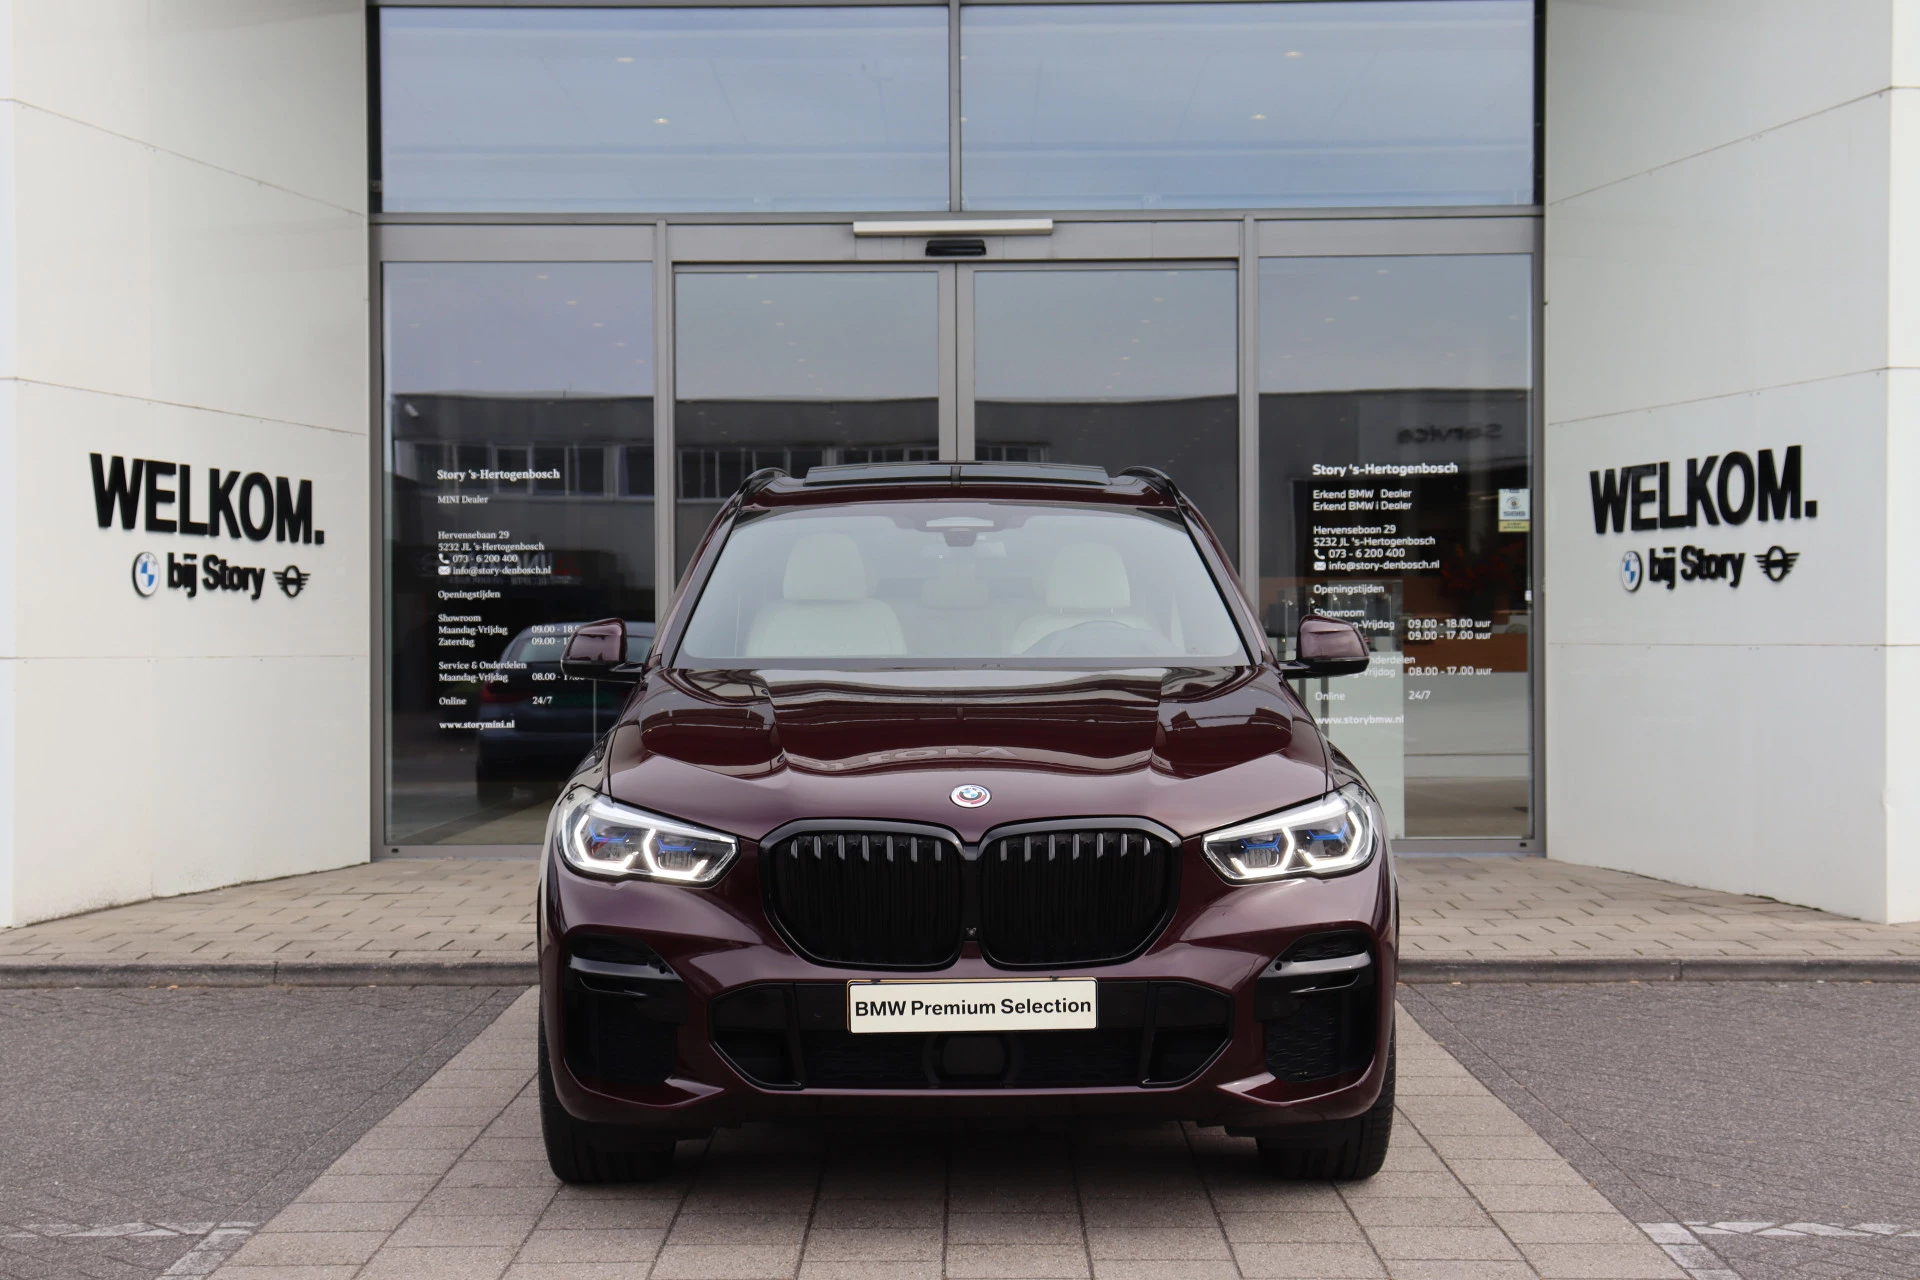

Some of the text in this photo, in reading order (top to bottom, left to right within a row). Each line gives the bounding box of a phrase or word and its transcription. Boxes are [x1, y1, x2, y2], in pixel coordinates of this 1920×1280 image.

[1312, 464, 1347, 477] Story
[437, 470, 466, 482] Story
[1313, 489, 1412, 499] Erkend BMW Dealer
[1589, 445, 1818, 535] WELKOM.
[90, 452, 325, 545] WELKOM.
[438, 494, 489, 504] MINI Dealer
[1313, 501, 1412, 511] Erkend BMW i Dealer
[438, 530, 510, 540] Hervensebaan 29
[1313, 525, 1396, 535] Hervensebaan 29
[438, 543, 459, 552] 5232
[461, 542, 472, 552] JL
[1313, 537, 1337, 547] 5232
[1338, 537, 1350, 547] JL
[1328, 549, 1346, 559] 073
[1355, 549, 1362, 559] 6
[1364, 548, 1383, 558] 200
[1385, 547, 1406, 558] 400
[452, 554, 469, 564] 073
[475, 554, 482, 564] 6
[483, 554, 500, 564] 200
[501, 554, 519, 564] 400
[1328, 559, 1440, 572] info@story-denbosch.nl
[1649, 545, 1746, 590] bij Story
[167, 552, 266, 600] bij Story
[452, 565, 551, 577] info@story-denbosch.nl
[1313, 584, 1385, 595] Openingstijden
[438, 590, 501, 600] Openingstijden
[1314, 608, 1365, 617] Showroom
[438, 614, 482, 623] Showroom
[1408, 619, 1438, 629] 09.00
[1445, 618, 1473, 628] 18.00
[1475, 620, 1492, 628] uur
[438, 625, 508, 636] Maandag-Vrijdag
[531, 625, 555, 634] 09.00
[1408, 631, 1438, 641] 09.00
[1475, 631, 1492, 640] uur
[438, 637, 475, 648] Zaterdag
[531, 637, 555, 645] 09.00
[1369, 656, 1416, 665] nderdelen
[438, 661, 527, 671] Service & Onderdelen
[1408, 667, 1438, 676] 08.00
[1475, 668, 1492, 676] uur
[438, 673, 509, 684] Maandag-Vrijdag
[531, 672, 556, 681] 08.00
[1315, 690, 1431, 701] Online 24/7
[439, 696, 553, 706] Online 24/7
[1315, 715, 1404, 725] www.storybmw.nl
[439, 720, 515, 731] www.storymini.nl
[855, 997, 1092, 1017] BMW Premium Selection
